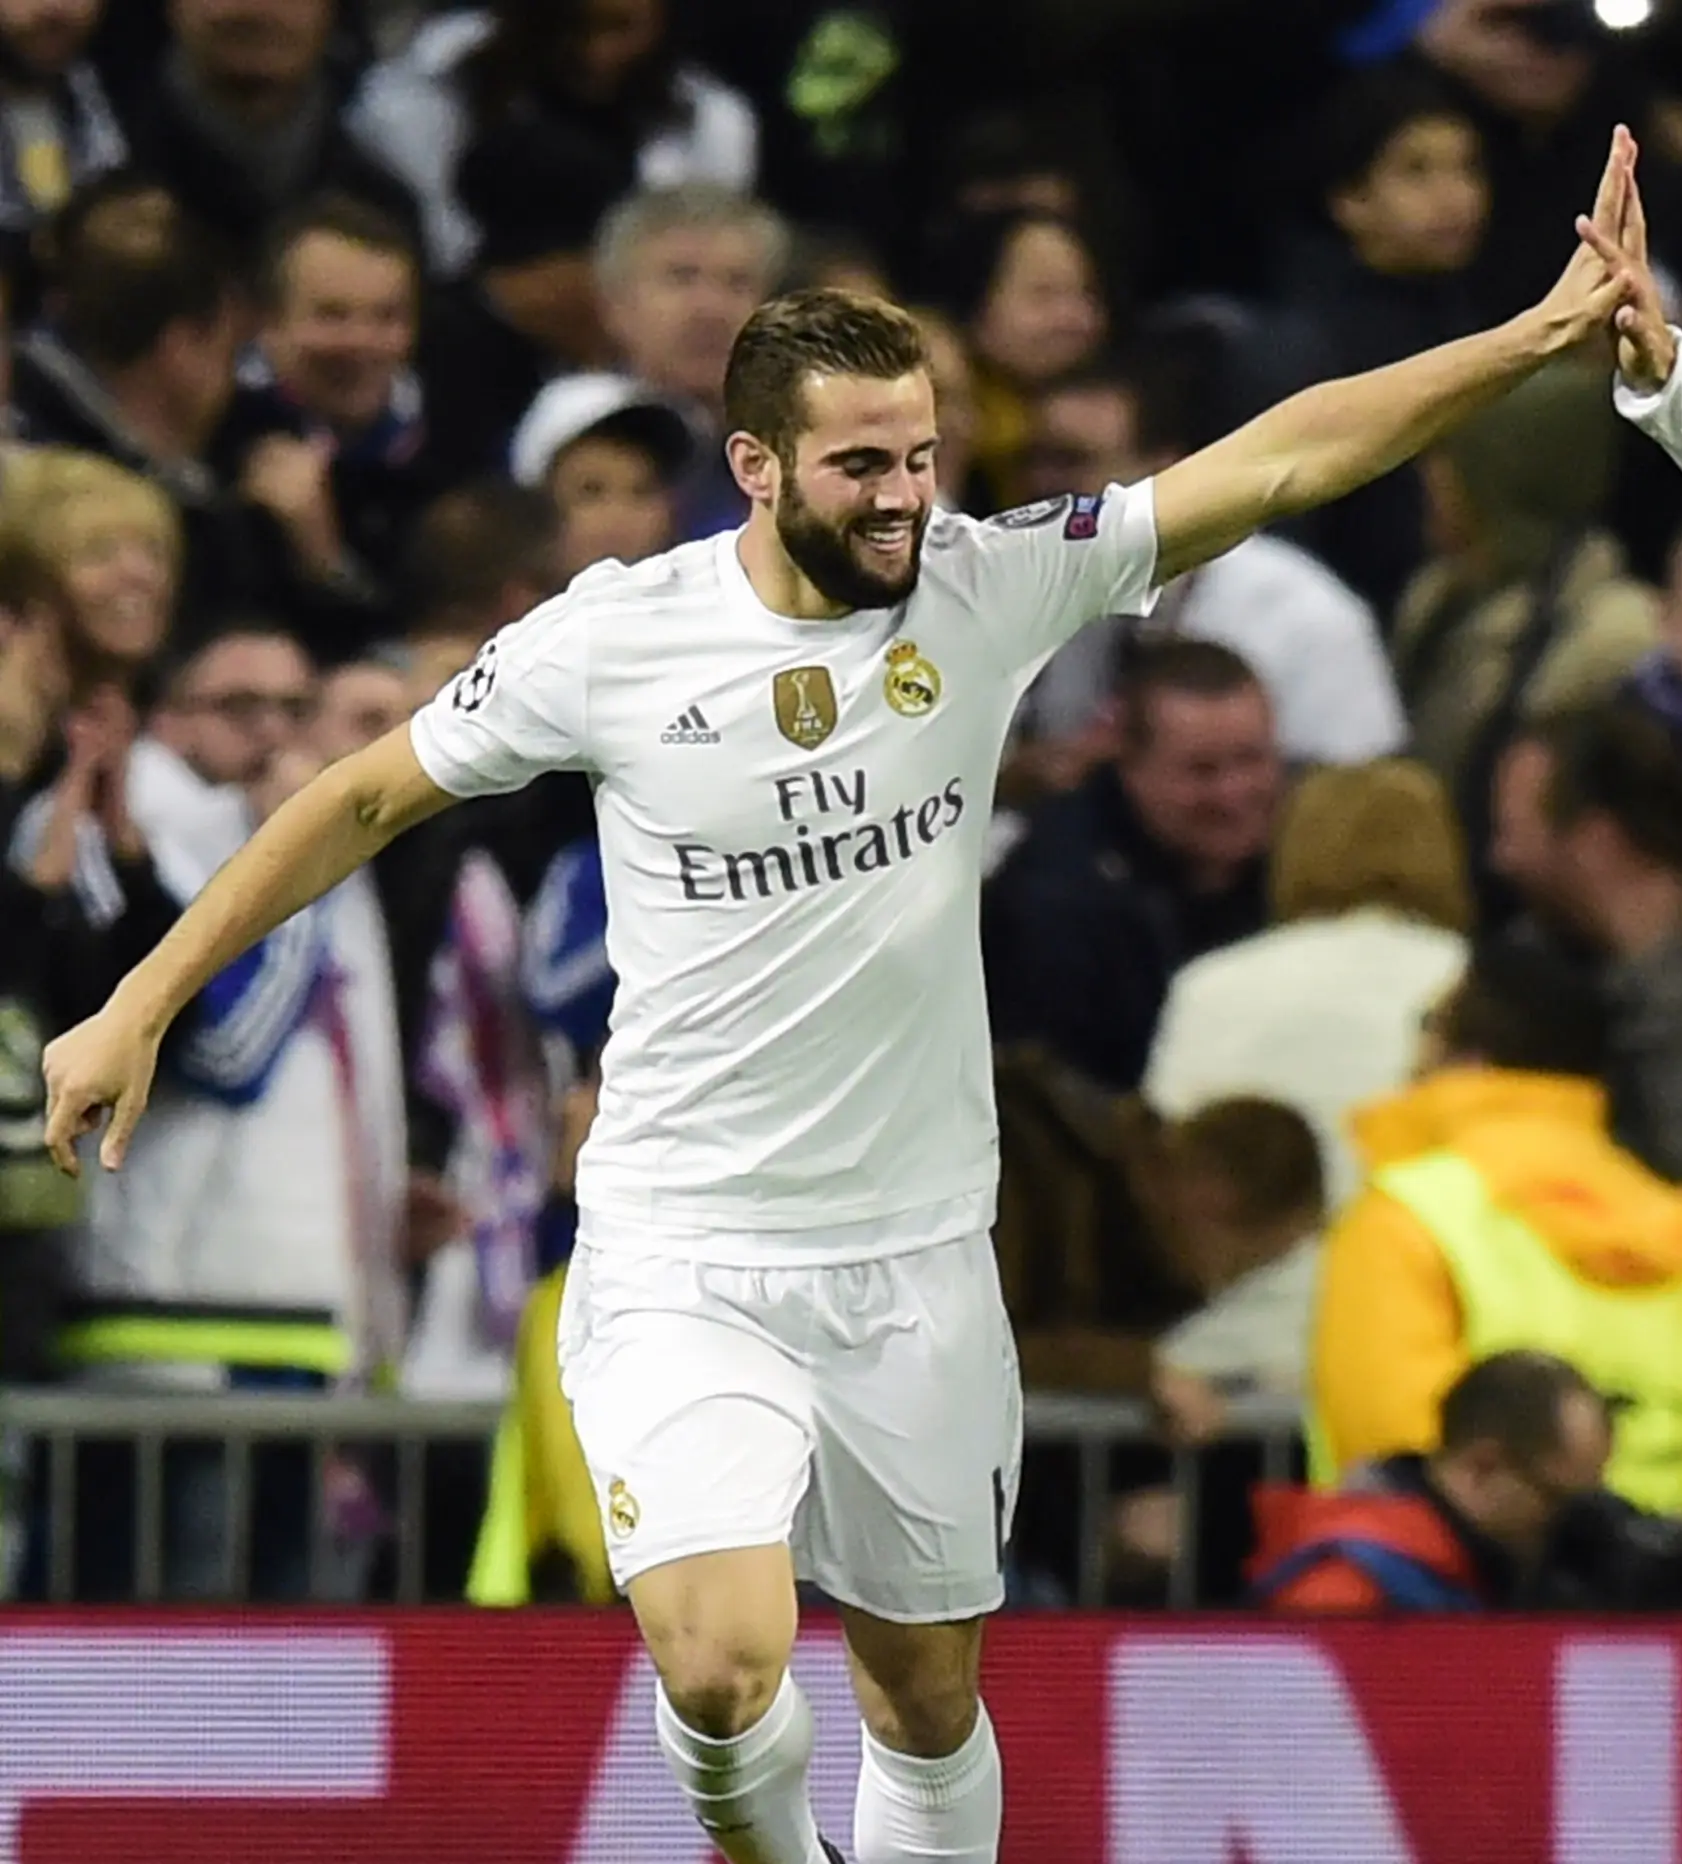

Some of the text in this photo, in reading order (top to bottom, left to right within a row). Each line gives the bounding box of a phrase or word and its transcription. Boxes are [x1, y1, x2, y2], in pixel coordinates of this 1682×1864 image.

[660, 730, 721, 745] adidas
[774, 769, 866, 822] Fly
[673, 776, 964, 900] Emirates
